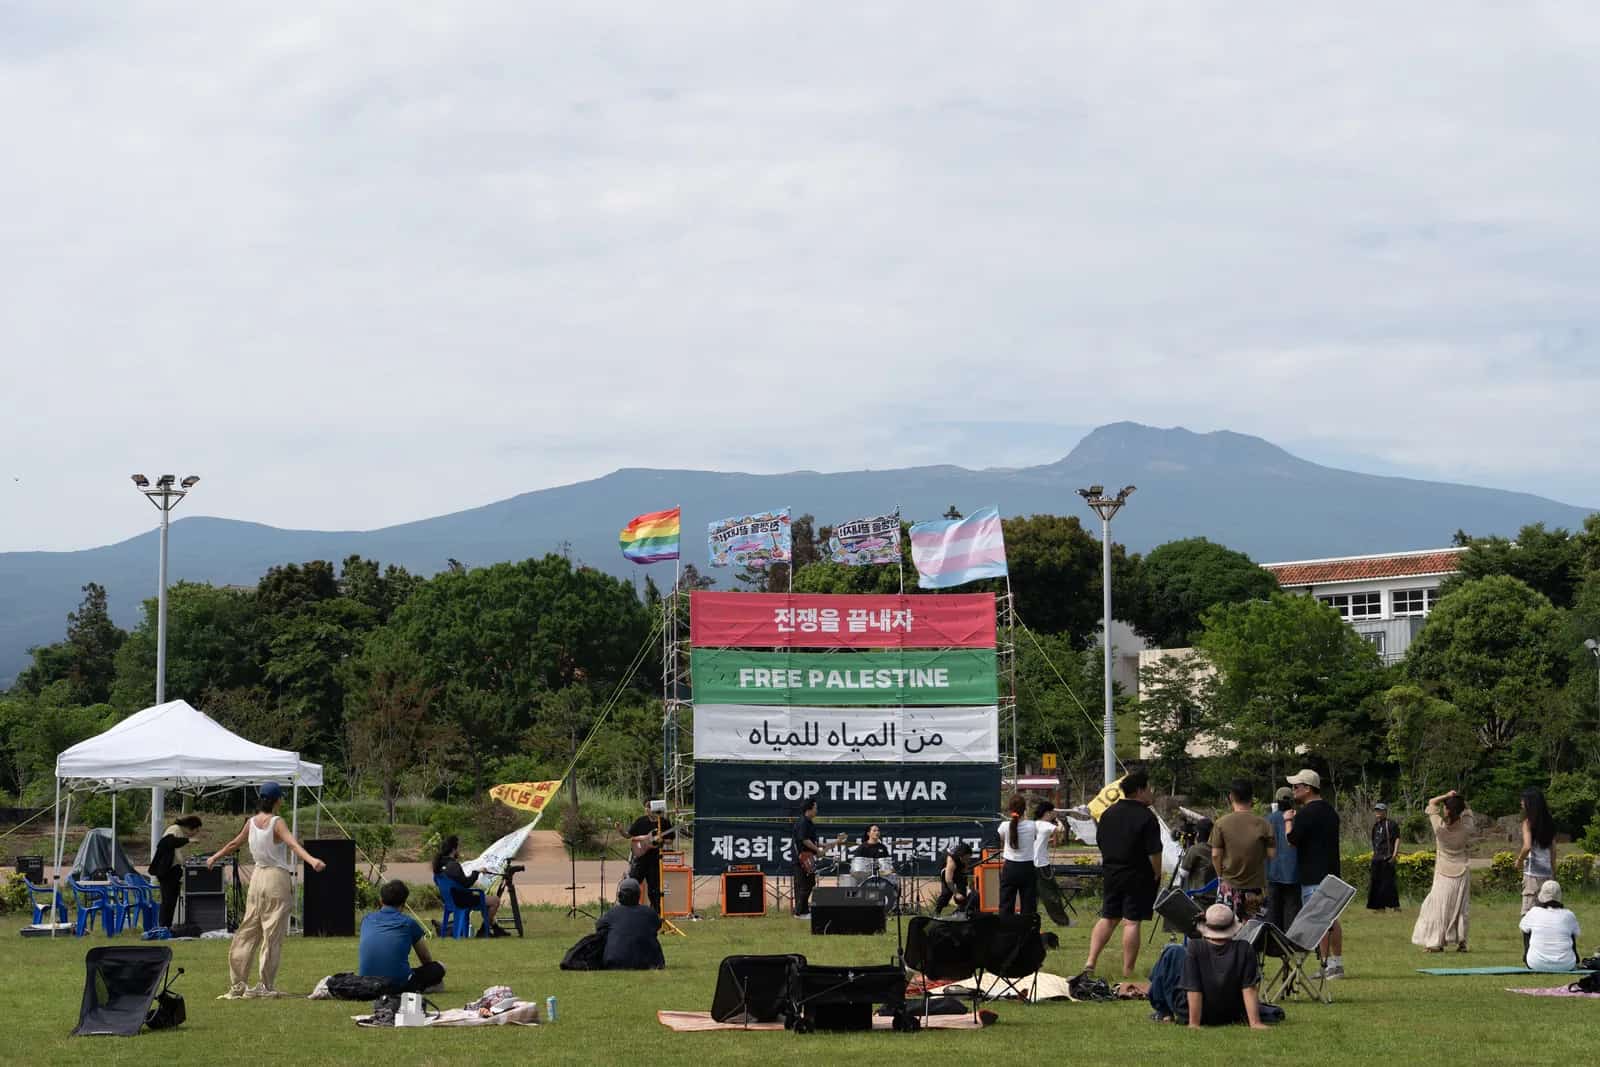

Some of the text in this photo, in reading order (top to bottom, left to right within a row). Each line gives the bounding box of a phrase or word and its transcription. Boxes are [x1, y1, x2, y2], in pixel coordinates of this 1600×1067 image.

[773, 607, 914, 633] 전쟁을 끝내자
[739, 668, 949, 689] FREE PALESTINE
[748, 720, 943, 753] من المياه للمياه
[748, 780, 947, 801] STOP THE WAR
[711, 835, 773, 861] 제3회
